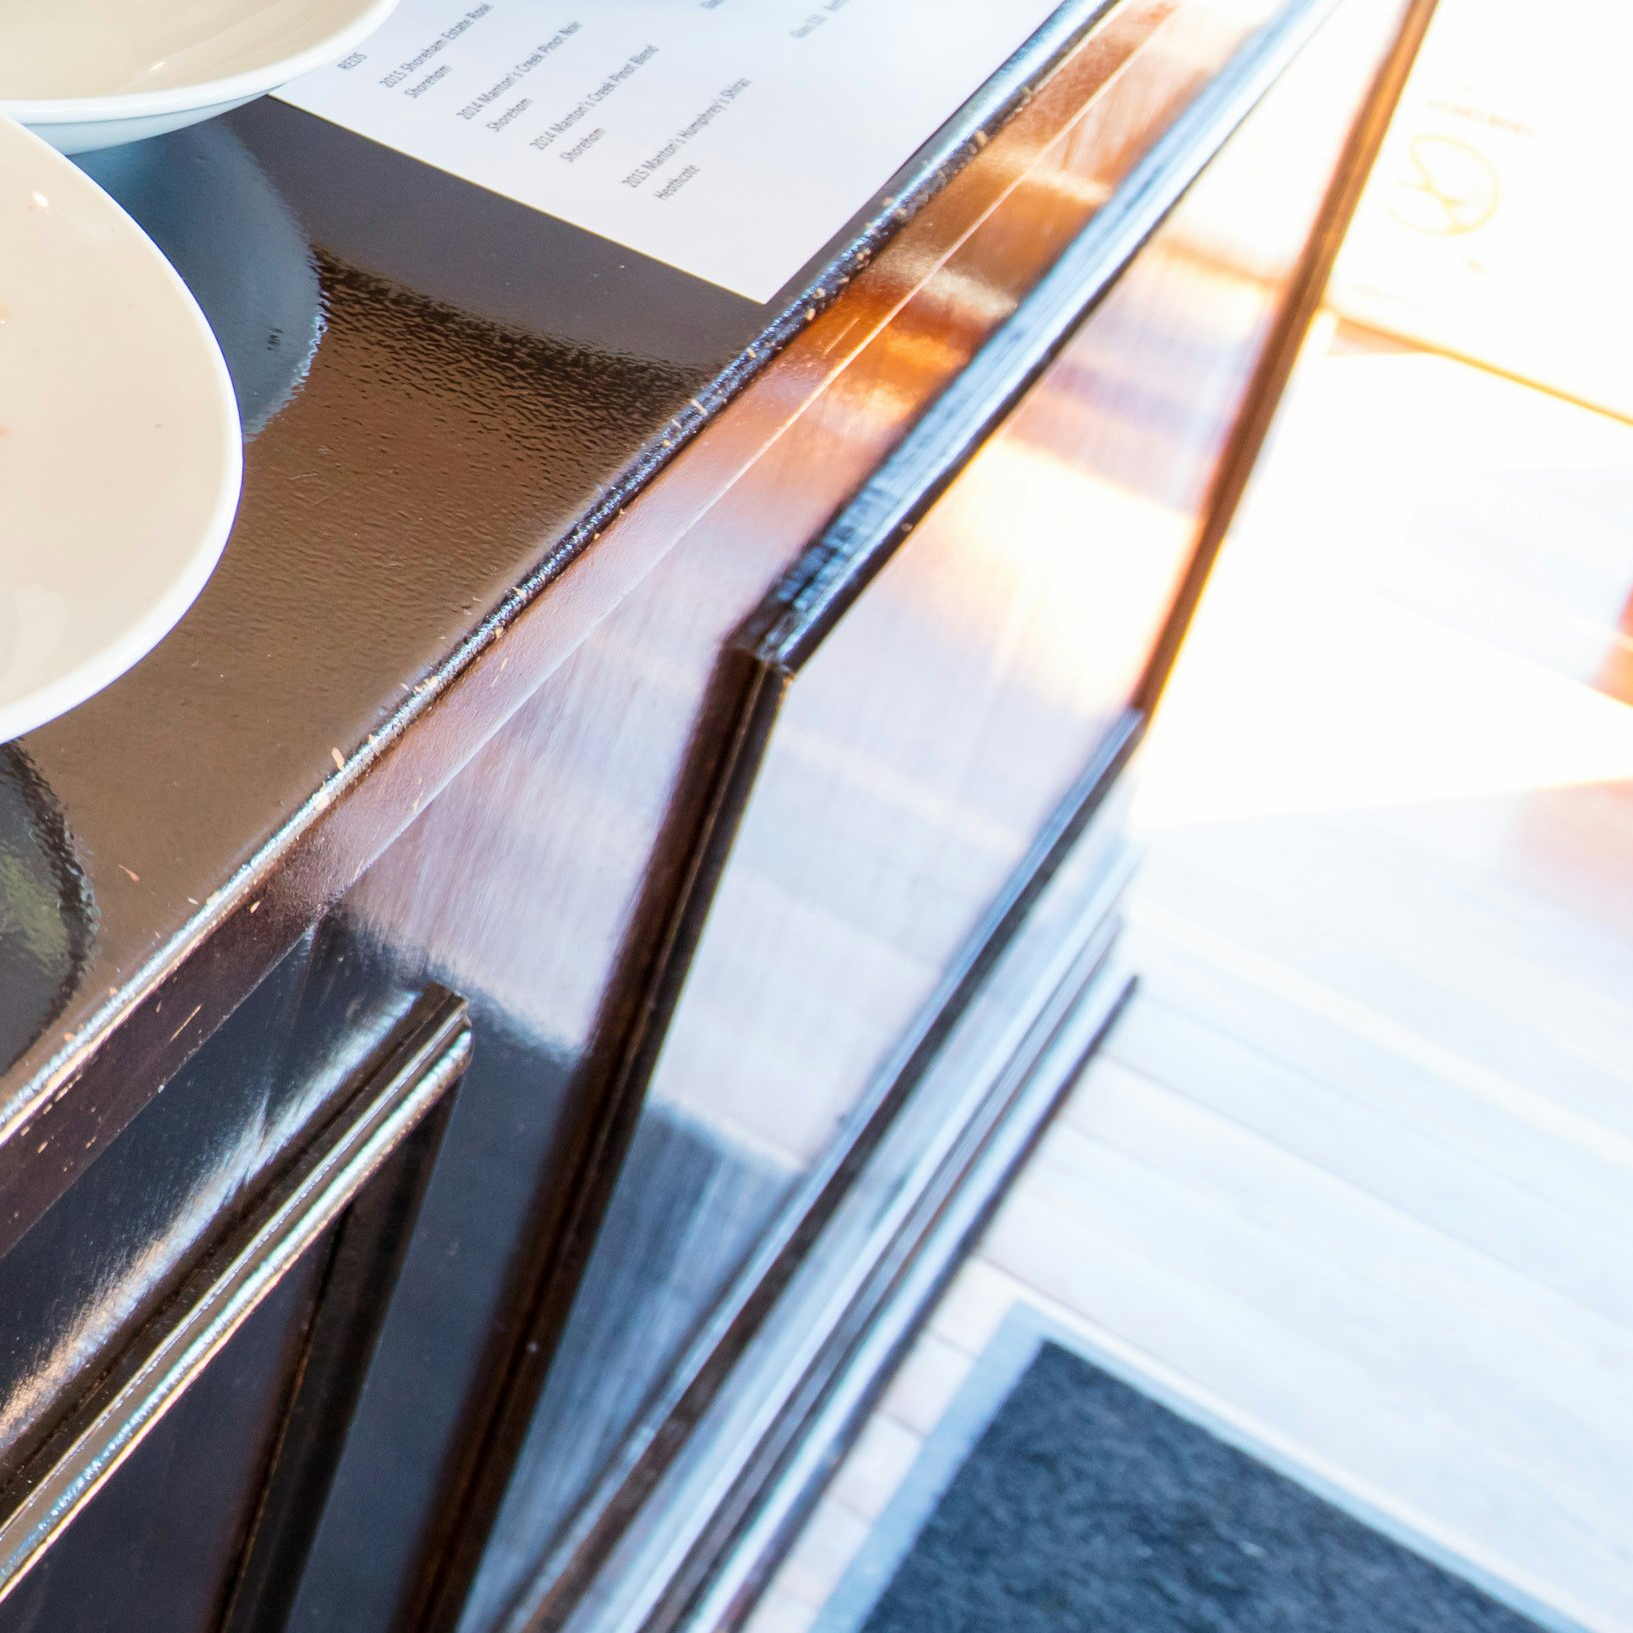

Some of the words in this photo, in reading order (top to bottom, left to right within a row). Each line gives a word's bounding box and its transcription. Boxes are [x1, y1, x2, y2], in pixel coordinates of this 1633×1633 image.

[337, 52, 367, 70] REDS
[379, 70, 407, 88] 2015
[400, 39, 448, 72] Shoreham
[441, 19, 474, 40] Estate
[456, 102, 484, 120] 2014
[477, 72, 523, 103] Manton's
[516, 53, 545, 72] Creek
[537, 33, 567, 53] Pinot
[559, 20, 582, 36] Noir
[404, 65, 452, 98] Shoreham
[529, 131, 557, 150] 2014
[550, 101, 595, 133] Manton's
[587, 82, 618, 102] Creek
[609, 64, 638, 82] Pinot
[629, 44, 659, 65] Blend
[486, 98, 533, 132] Shoreham
[560, 128, 606, 162] Shoreham
[621, 169, 651, 188] 2015
[641, 138, 686, 171] Manton's
[677, 98, 730, 139] Humphrey's
[653, 165, 700, 200] Heathcote
